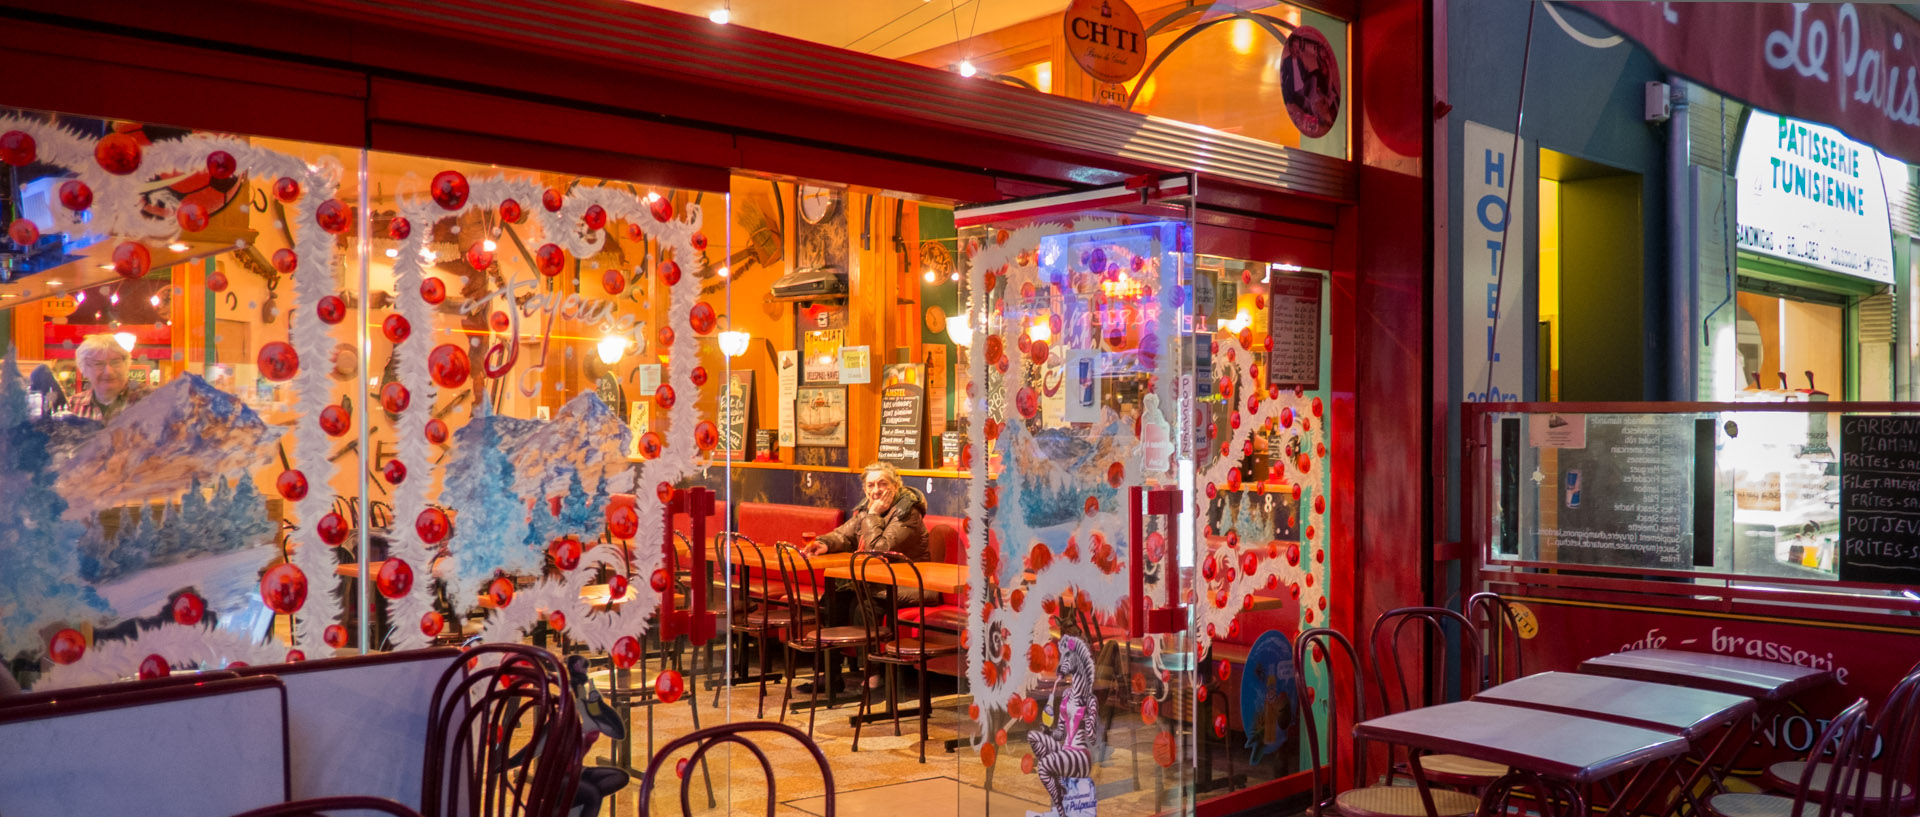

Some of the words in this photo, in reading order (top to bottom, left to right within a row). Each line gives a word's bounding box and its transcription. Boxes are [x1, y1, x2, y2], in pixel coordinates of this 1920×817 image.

[1071, 16, 1139, 55] CH'TI
[1778, 115, 1859, 179] PATISSERIE
[1770, 156, 1864, 216] TUNISIENNE
[1477, 149, 1512, 362] HOTEL
[885, 388, 906, 397] AMSTEL
[1860, 436, 1920, 454] FLAMAN
[1263, 493, 1273, 513] 8
[1847, 515, 1920, 535] POTJEV
[1711, 626, 1849, 686] brasserie
